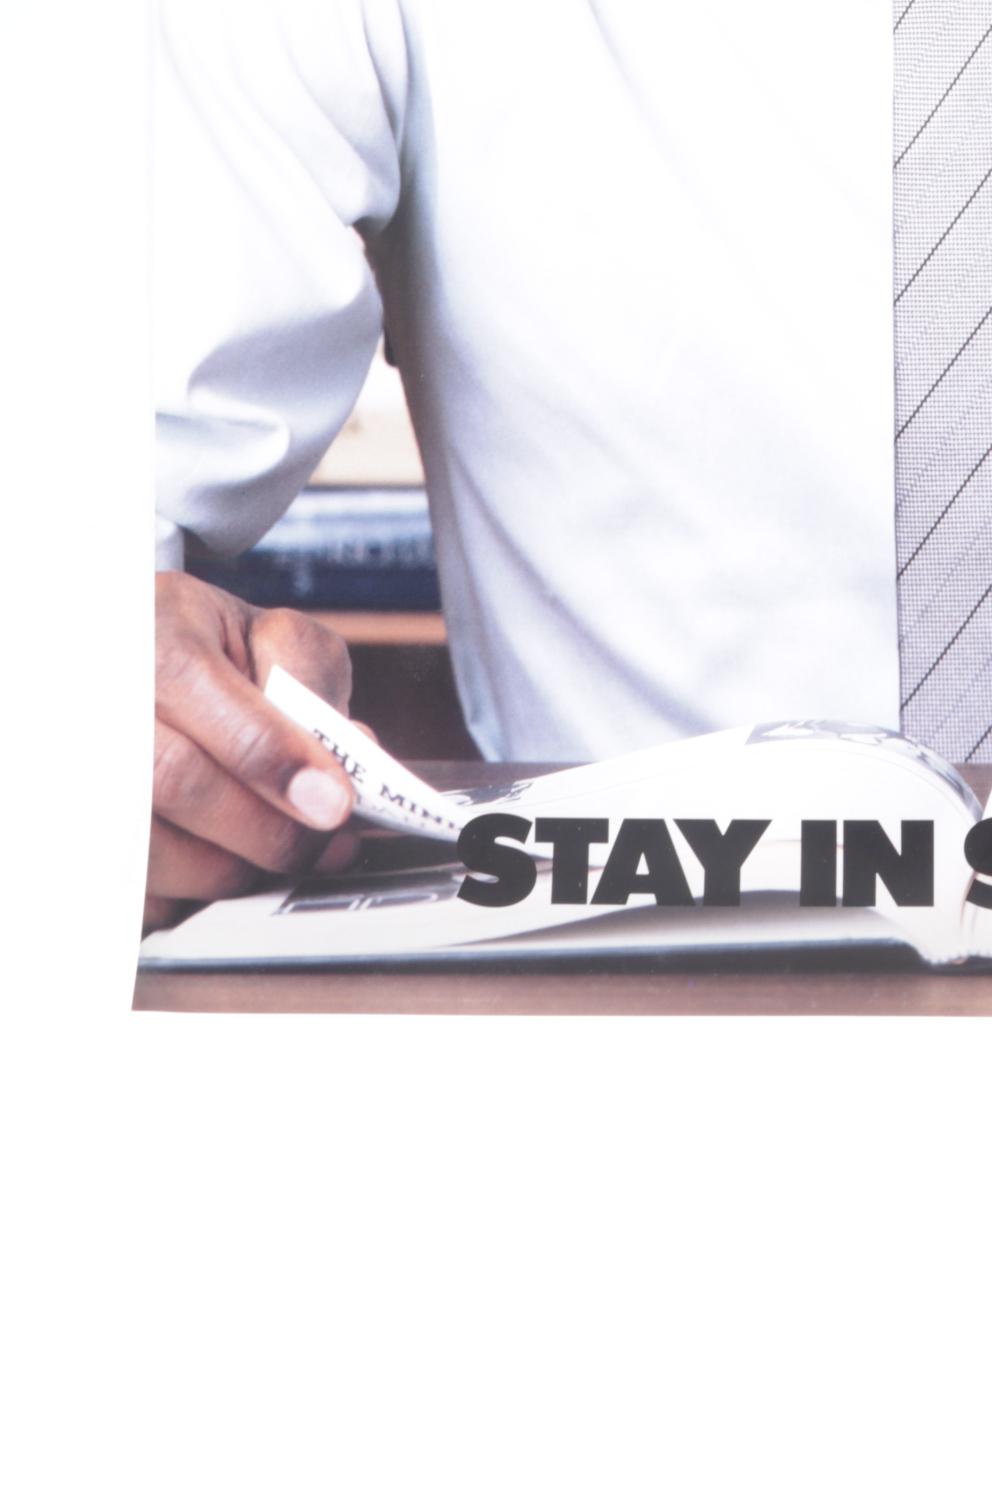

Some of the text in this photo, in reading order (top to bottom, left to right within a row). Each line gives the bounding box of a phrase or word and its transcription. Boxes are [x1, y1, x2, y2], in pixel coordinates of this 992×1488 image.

[314, 728, 366, 783] THE
[457, 812, 773, 908] STAY
[800, 819, 934, 908] IN
